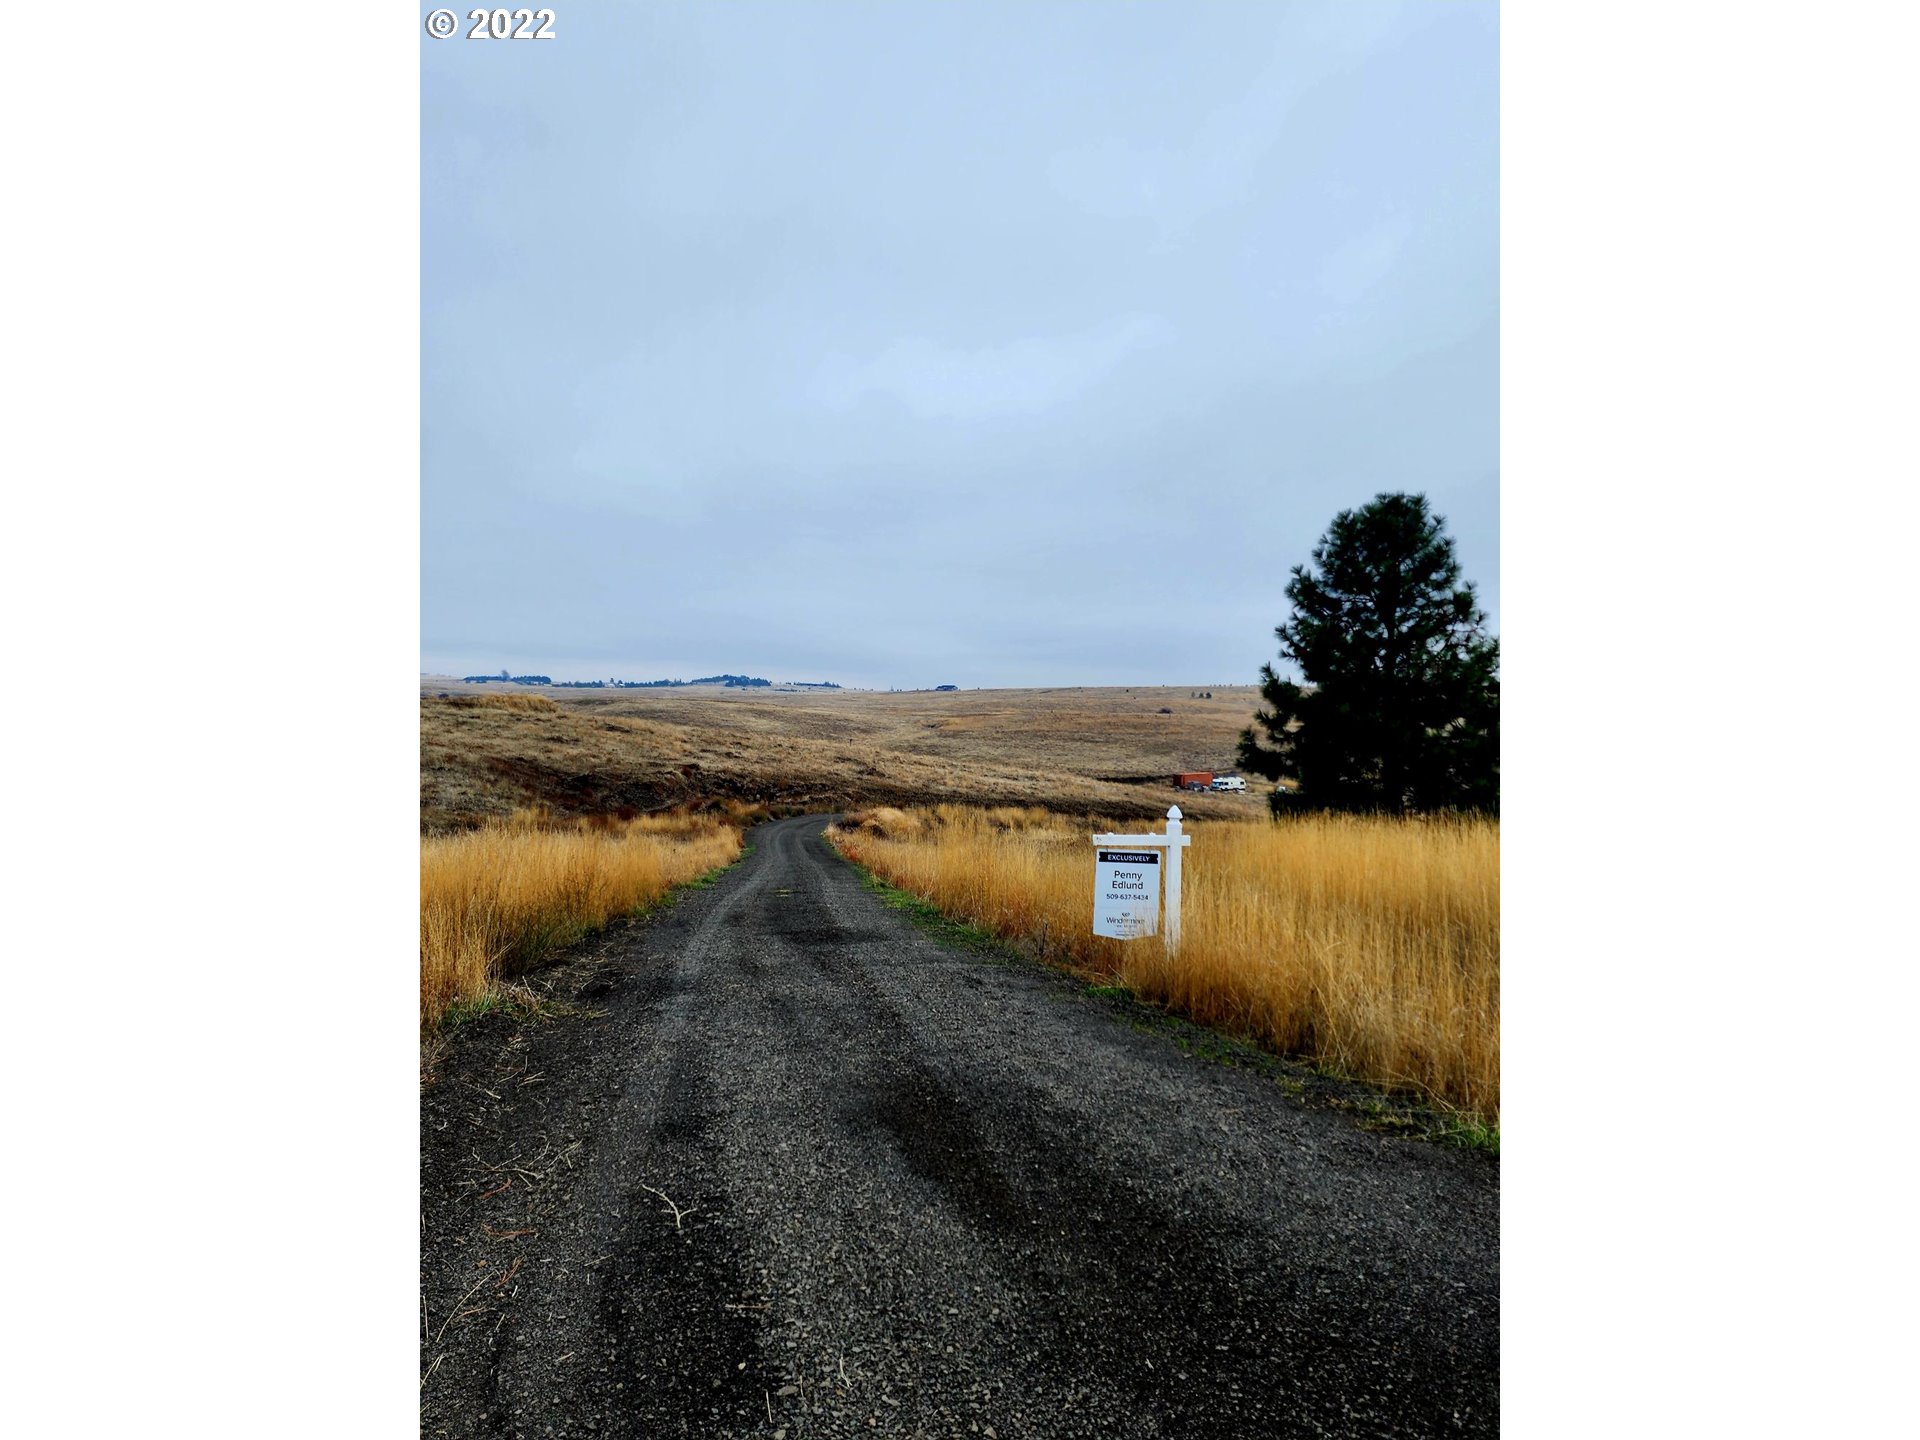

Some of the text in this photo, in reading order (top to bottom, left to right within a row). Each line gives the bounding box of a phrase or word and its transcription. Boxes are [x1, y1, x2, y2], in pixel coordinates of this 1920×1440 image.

[1107, 854, 1151, 862] EXCLUSIVELY
[1114, 870, 1143, 881] Penny
[1112, 880, 1144, 890] Edlund
